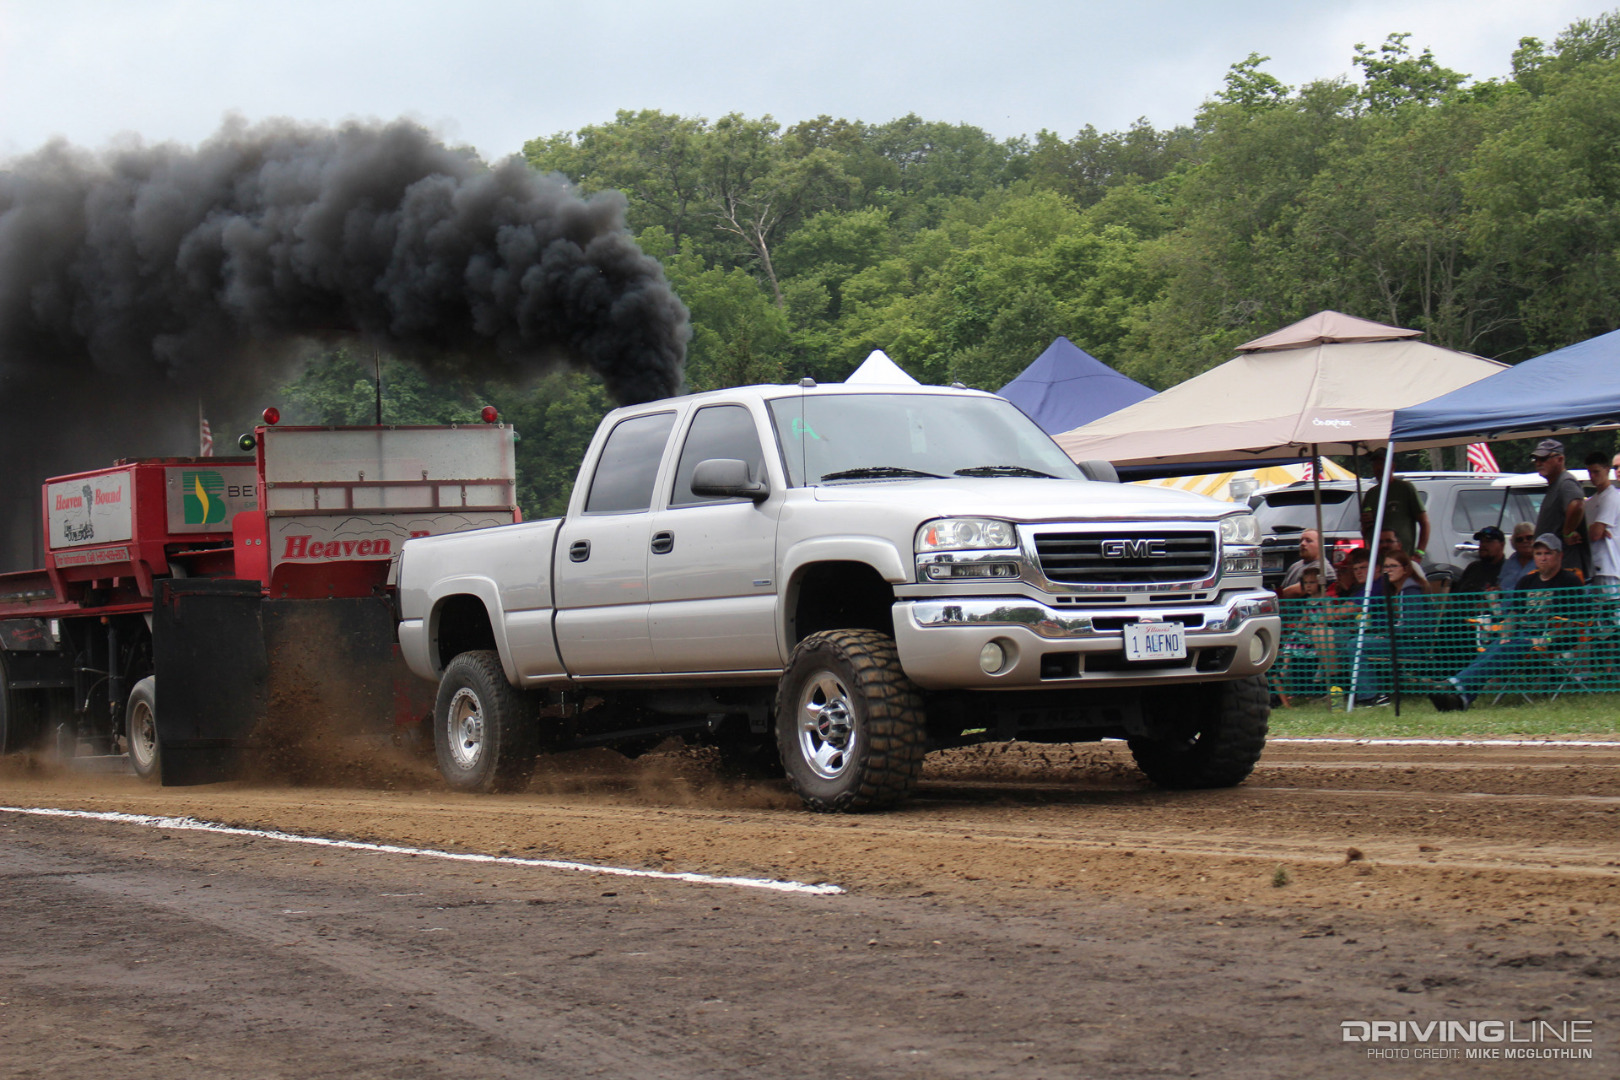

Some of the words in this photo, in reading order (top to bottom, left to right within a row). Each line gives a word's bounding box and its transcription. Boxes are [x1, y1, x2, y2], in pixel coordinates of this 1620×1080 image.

[55, 494, 83, 511] Heaven
[95, 485, 122, 505] Bound
[228, 486, 258, 497] BE
[281, 534, 392, 560] Heaven
[1101, 539, 1166, 559] GMC
[1133, 635, 1139, 653] 1
